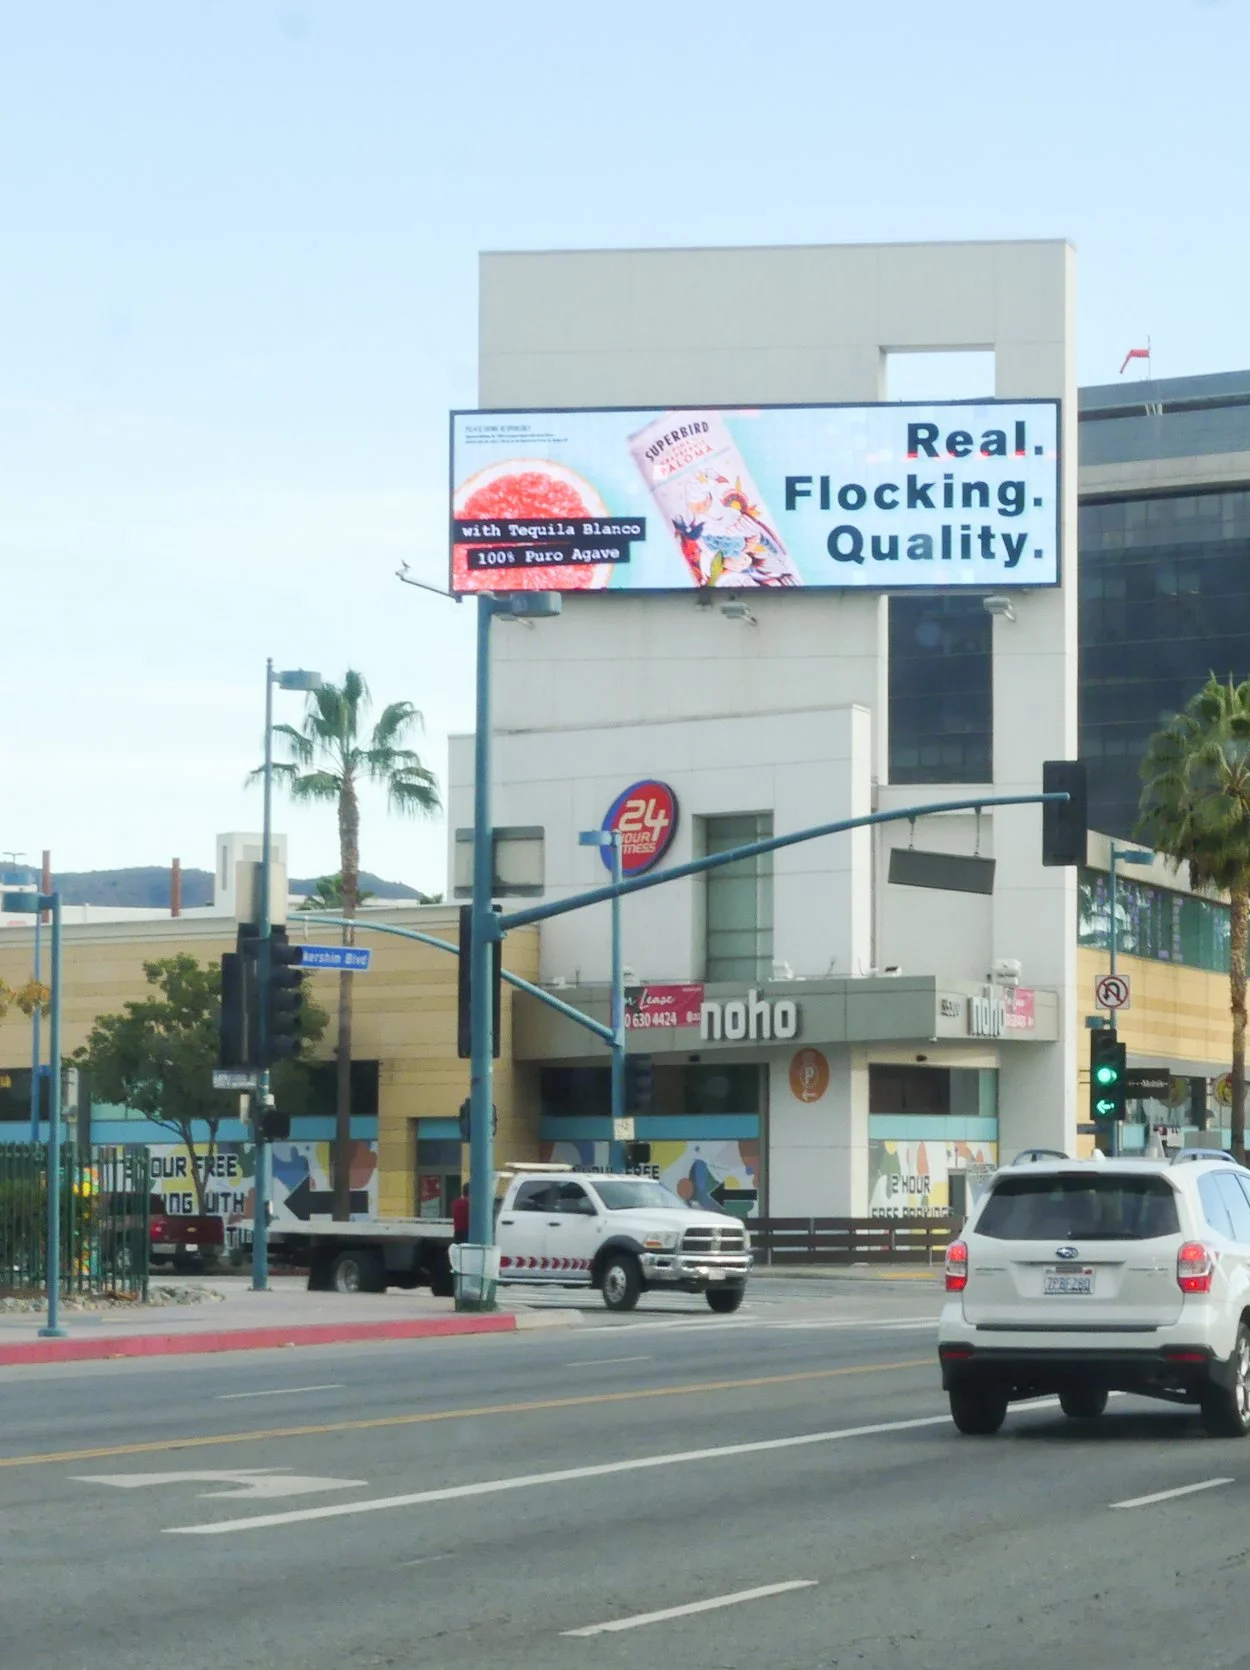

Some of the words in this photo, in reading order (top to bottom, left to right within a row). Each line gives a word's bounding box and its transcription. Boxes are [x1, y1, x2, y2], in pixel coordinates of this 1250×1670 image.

[644, 420, 709, 463] SUPERBIRD
[906, 420, 1044, 458] Real.
[784, 473, 1043, 517] Flocking.
[462, 525, 501, 537] with
[508, 523, 575, 539] Tequila
[583, 523, 641, 537] Blanco
[478, 551, 515, 565] 100%
[525, 549, 563, 563] Puro
[571, 547, 620, 563] Agave
[826, 524, 1044, 568] Quality.
[619, 798, 669, 842] 24
[622, 831, 651, 844] OUR
[302, 949, 342, 964] kershim
[344, 952, 368, 966] Blvd
[652, 1011, 677, 1027] 4424
[700, 988, 797, 1040] noho
[150, 1157, 187, 1178] OUR
[891, 1175, 899, 1193] 2
[901, 1175, 931, 1193] HOUR
